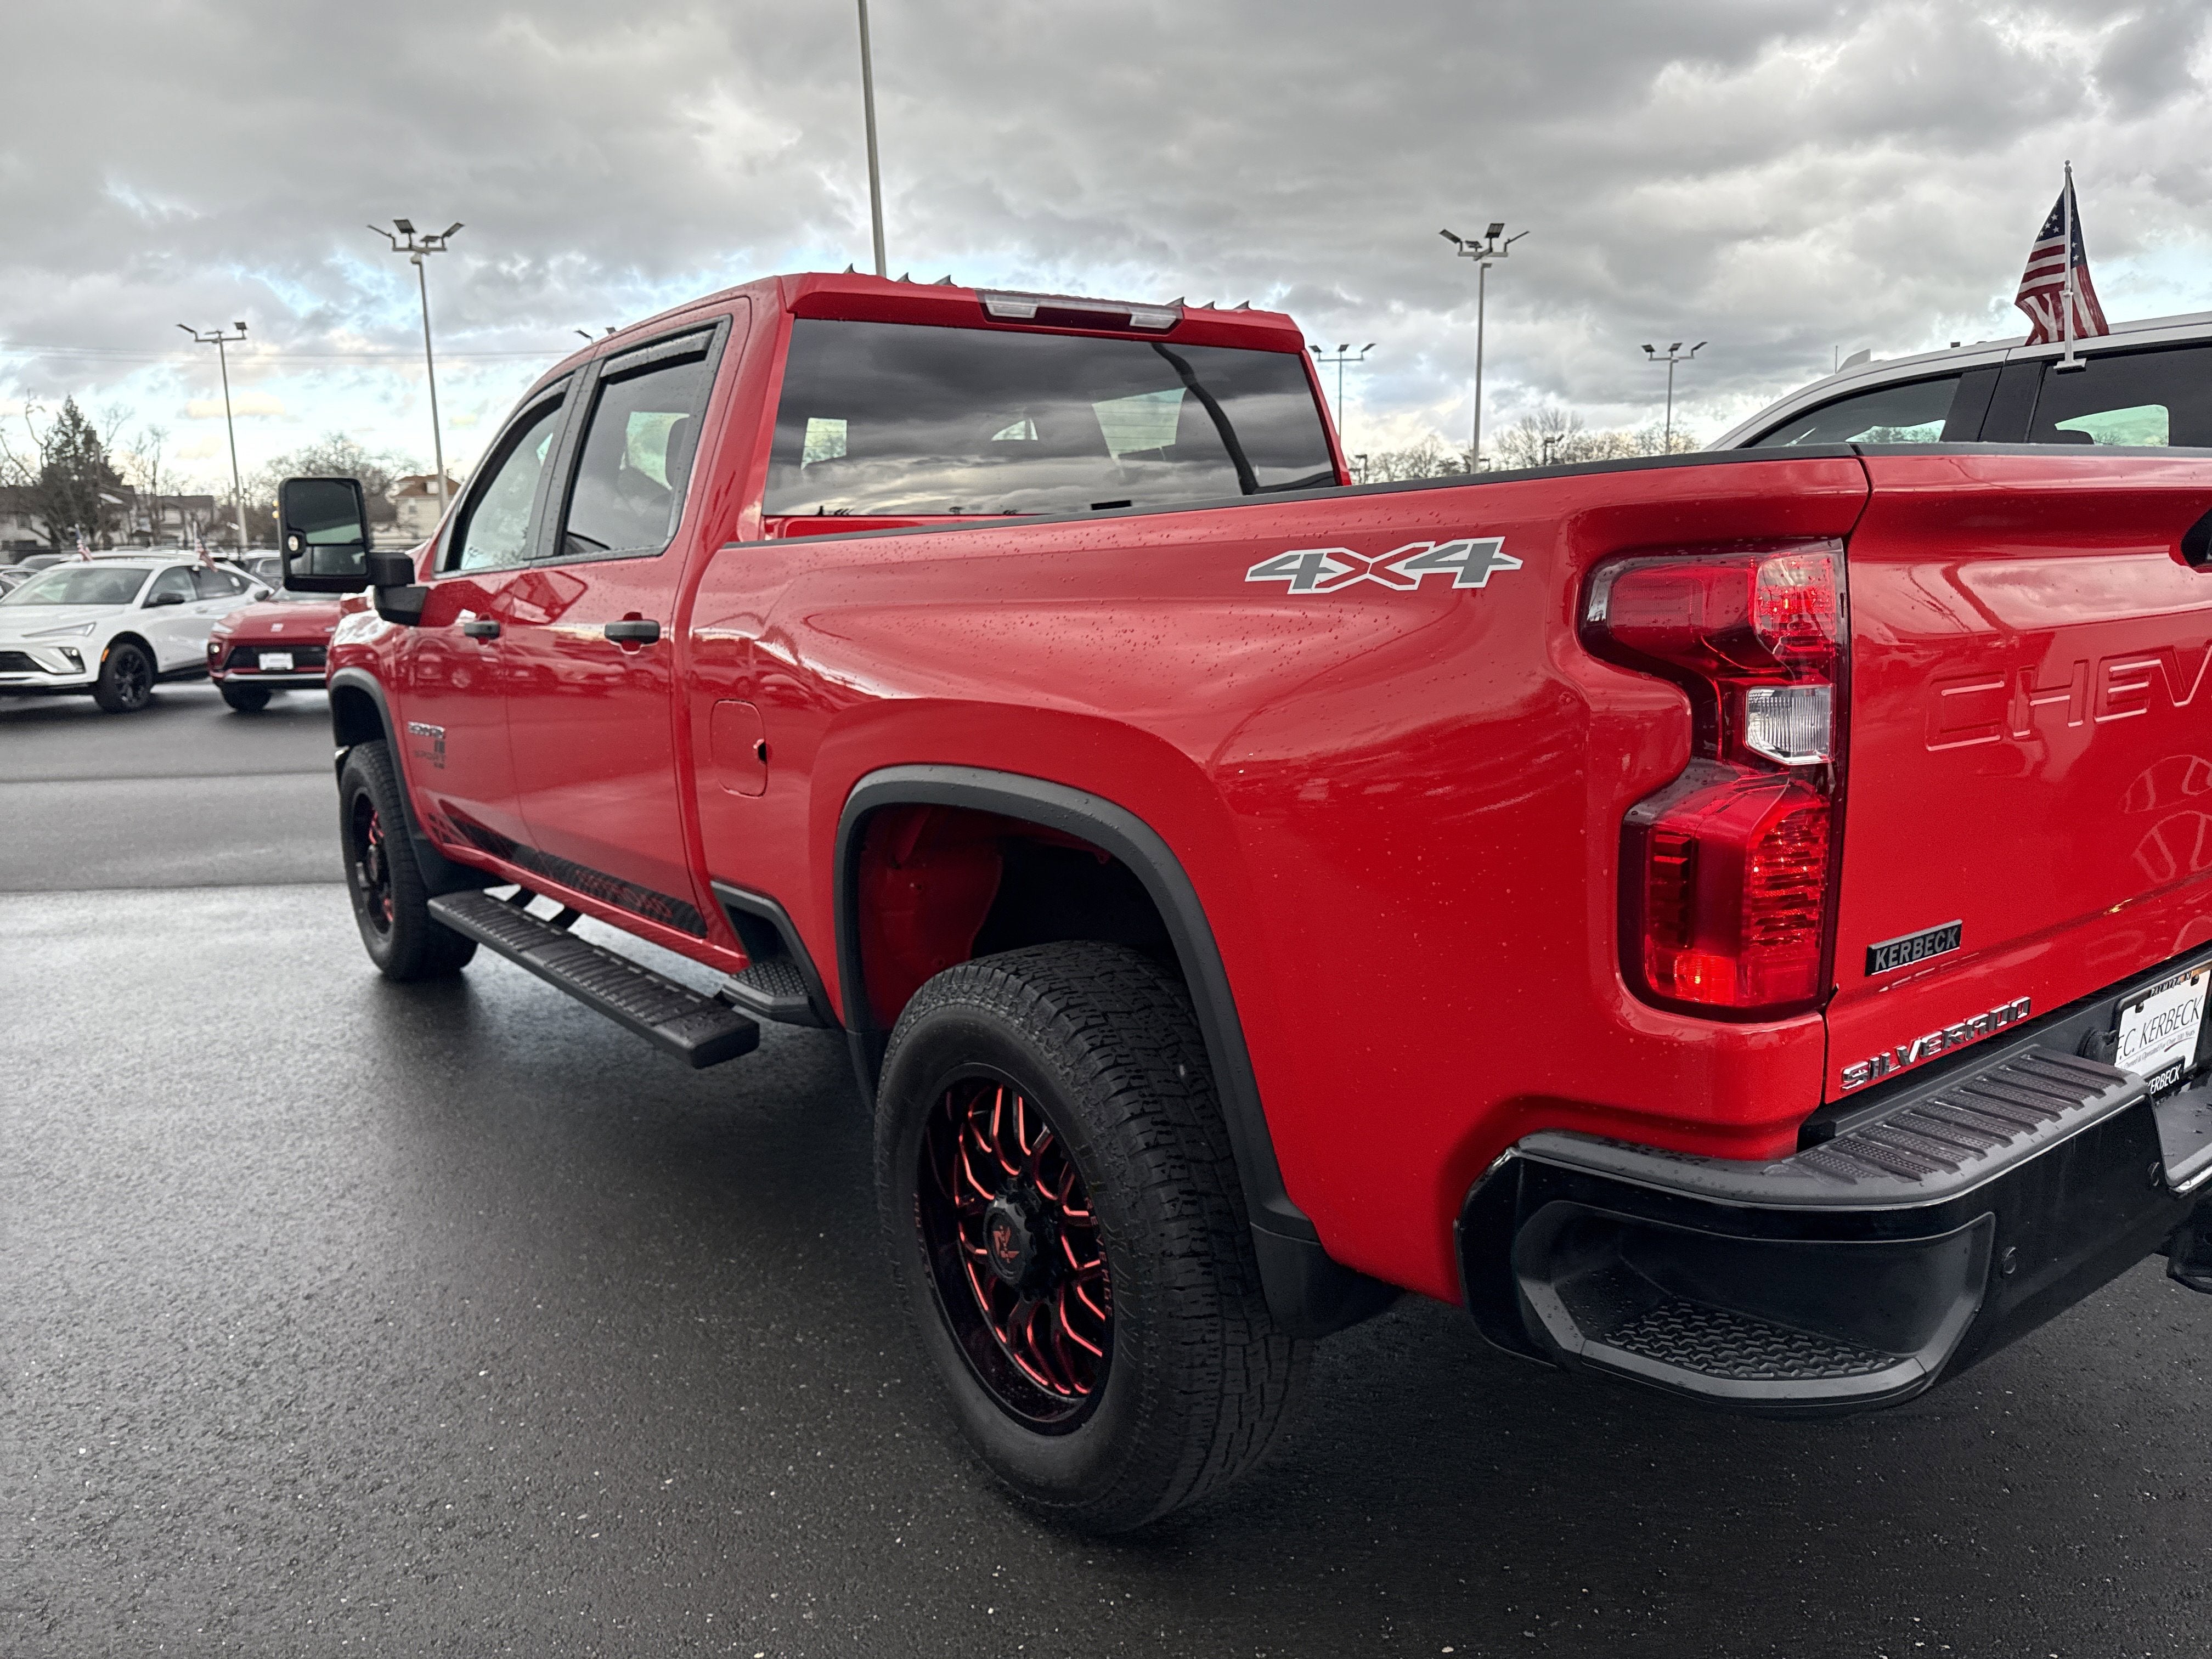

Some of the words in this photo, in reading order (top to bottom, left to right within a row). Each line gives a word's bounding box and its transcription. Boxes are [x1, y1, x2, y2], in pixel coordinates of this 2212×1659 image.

[1875, 927, 1957, 972] KERBECK
[1839, 996, 2032, 1090] SILVERADO
[2140, 995, 2203, 1048] KERBECK
